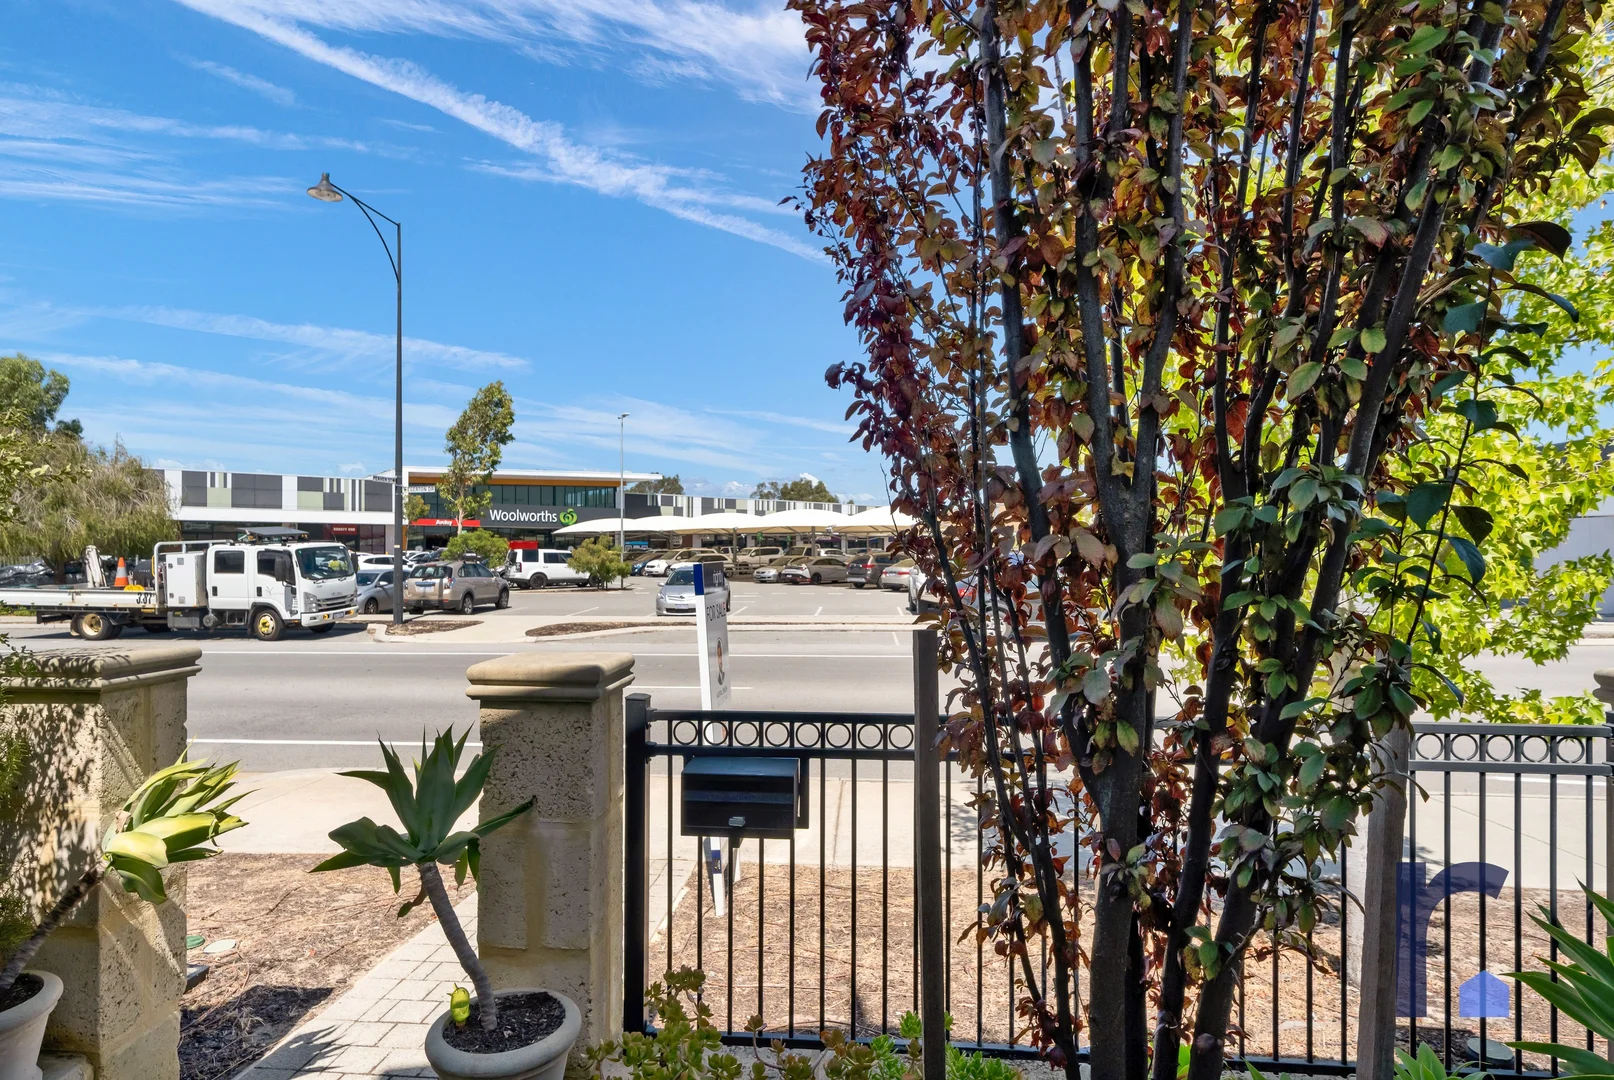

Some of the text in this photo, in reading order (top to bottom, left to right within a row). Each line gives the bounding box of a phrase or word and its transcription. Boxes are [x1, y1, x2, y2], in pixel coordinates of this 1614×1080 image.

[489, 508, 558, 522] Woolworths
[706, 601, 726, 622] FOR SALE
